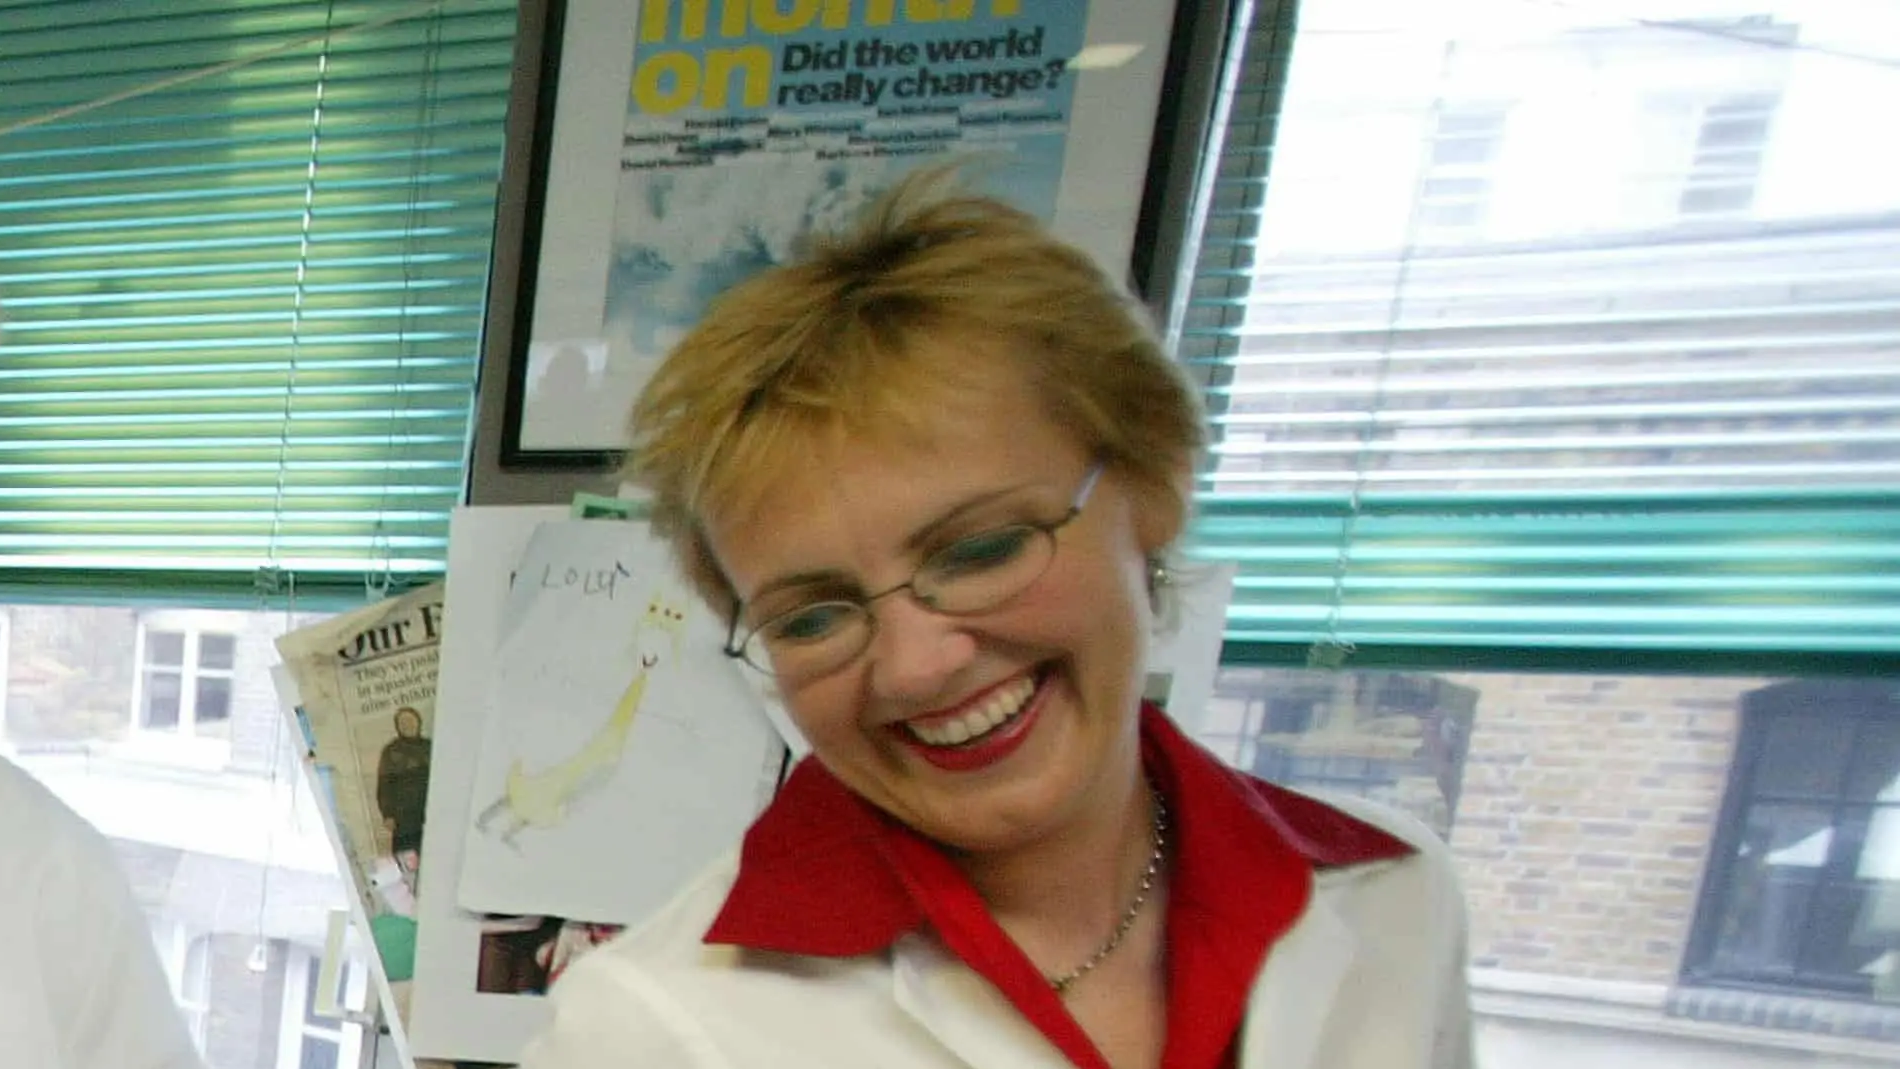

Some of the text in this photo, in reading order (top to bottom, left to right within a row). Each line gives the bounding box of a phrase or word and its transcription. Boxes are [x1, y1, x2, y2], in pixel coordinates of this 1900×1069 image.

[639, 0, 1021, 42] mon
[782, 26, 1045, 74] Did the world
[632, 44, 774, 115] on
[777, 56, 1068, 107] really change?
